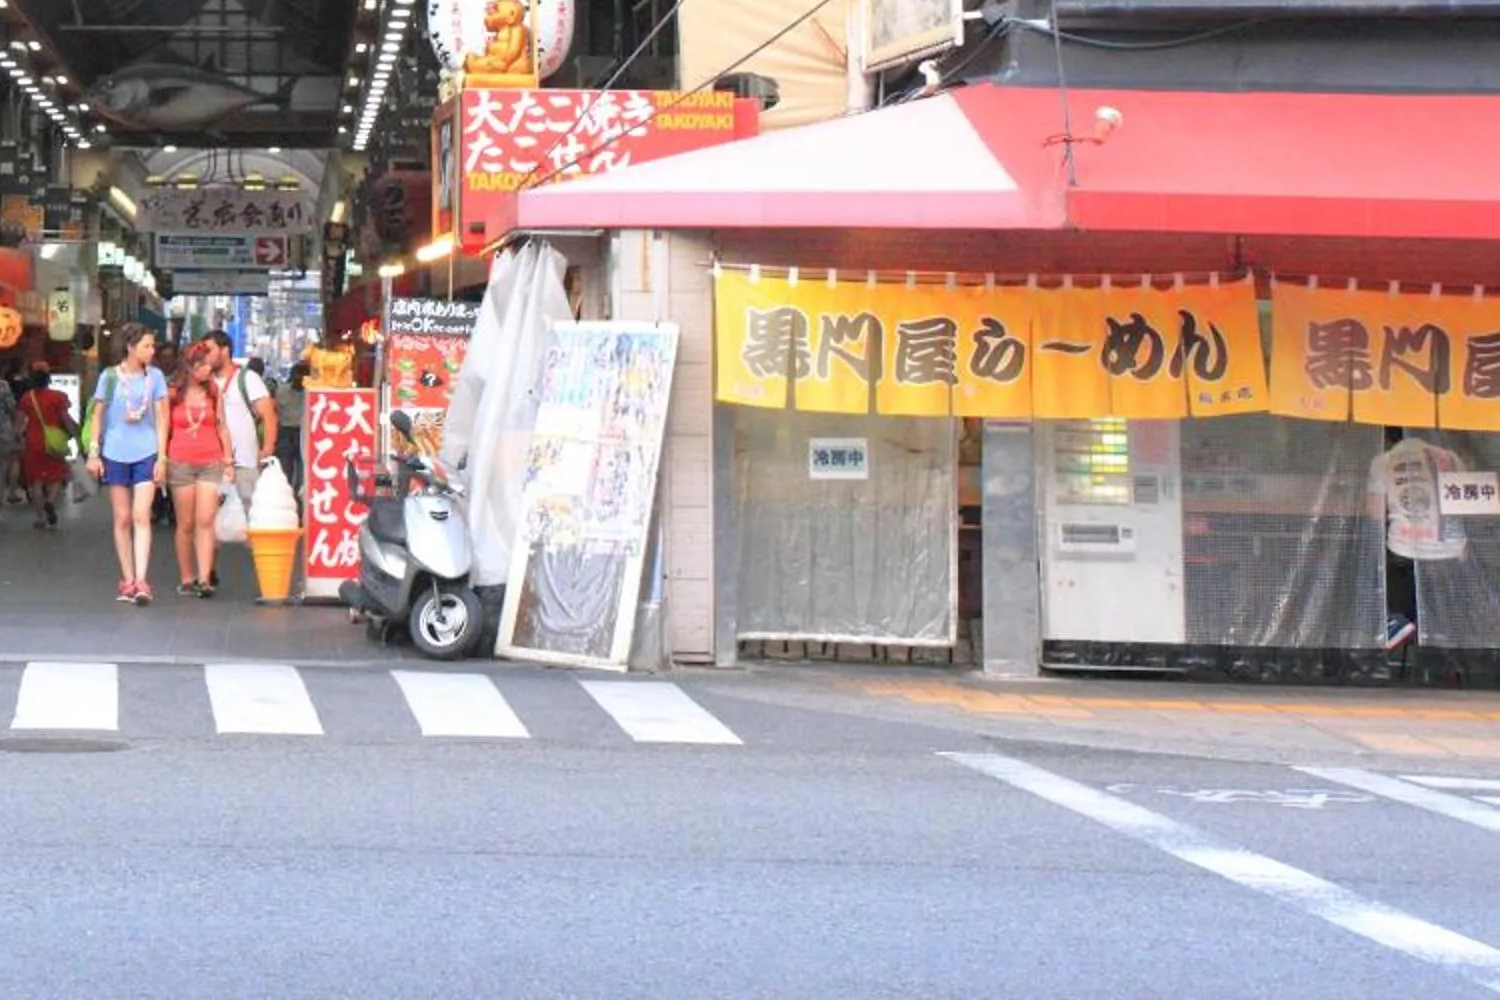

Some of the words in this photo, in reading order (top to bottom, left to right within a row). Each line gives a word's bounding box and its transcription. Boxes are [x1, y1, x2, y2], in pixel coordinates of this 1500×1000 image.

[464, 89, 655, 137] 大たこ焼き
[656, 113, 734, 129] TAKOYAKI
[465, 132, 632, 173] たこせん
[743, 307, 1228, 386] 黒門屋らーめん
[813, 448, 864, 467] 冷房中
[309, 393, 342, 568] たこせん
[1443, 483, 1495, 500] 冷房中
